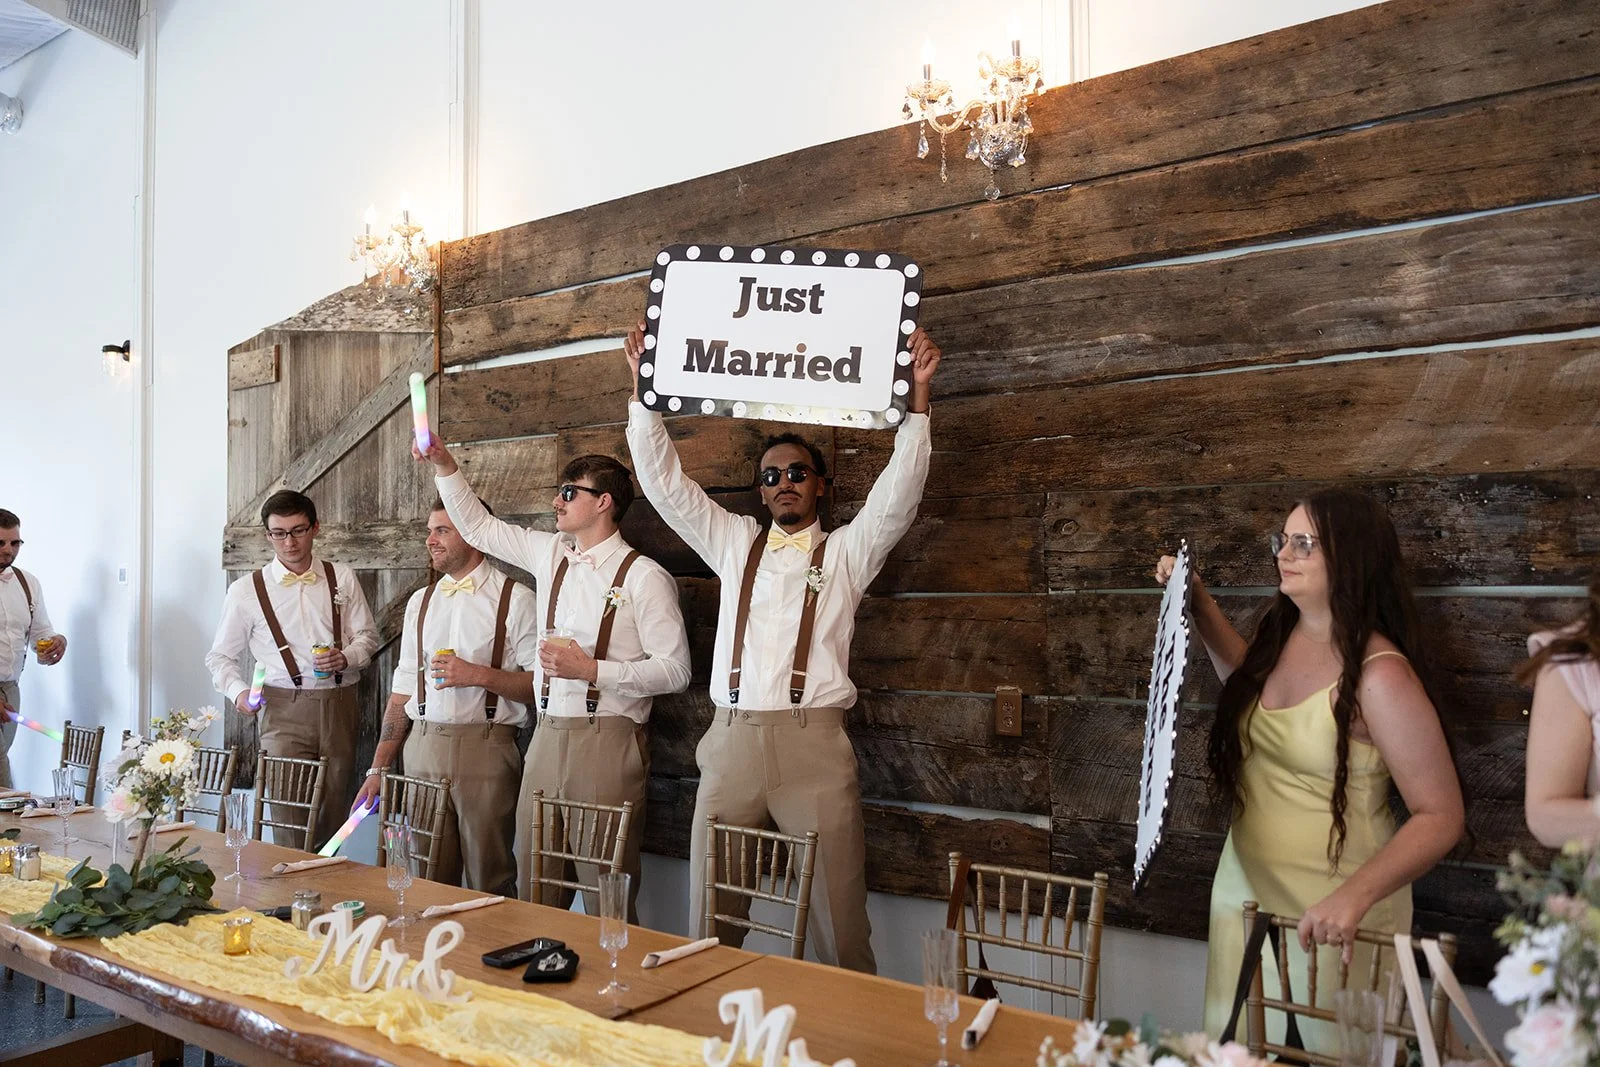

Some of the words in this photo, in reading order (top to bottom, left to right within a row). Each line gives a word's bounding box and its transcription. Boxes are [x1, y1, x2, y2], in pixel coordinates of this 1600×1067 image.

[732, 276, 825, 318] Just
[682, 338, 863, 384] Married
[1159, 630, 1176, 732] The
[410, 920, 473, 1003] &
